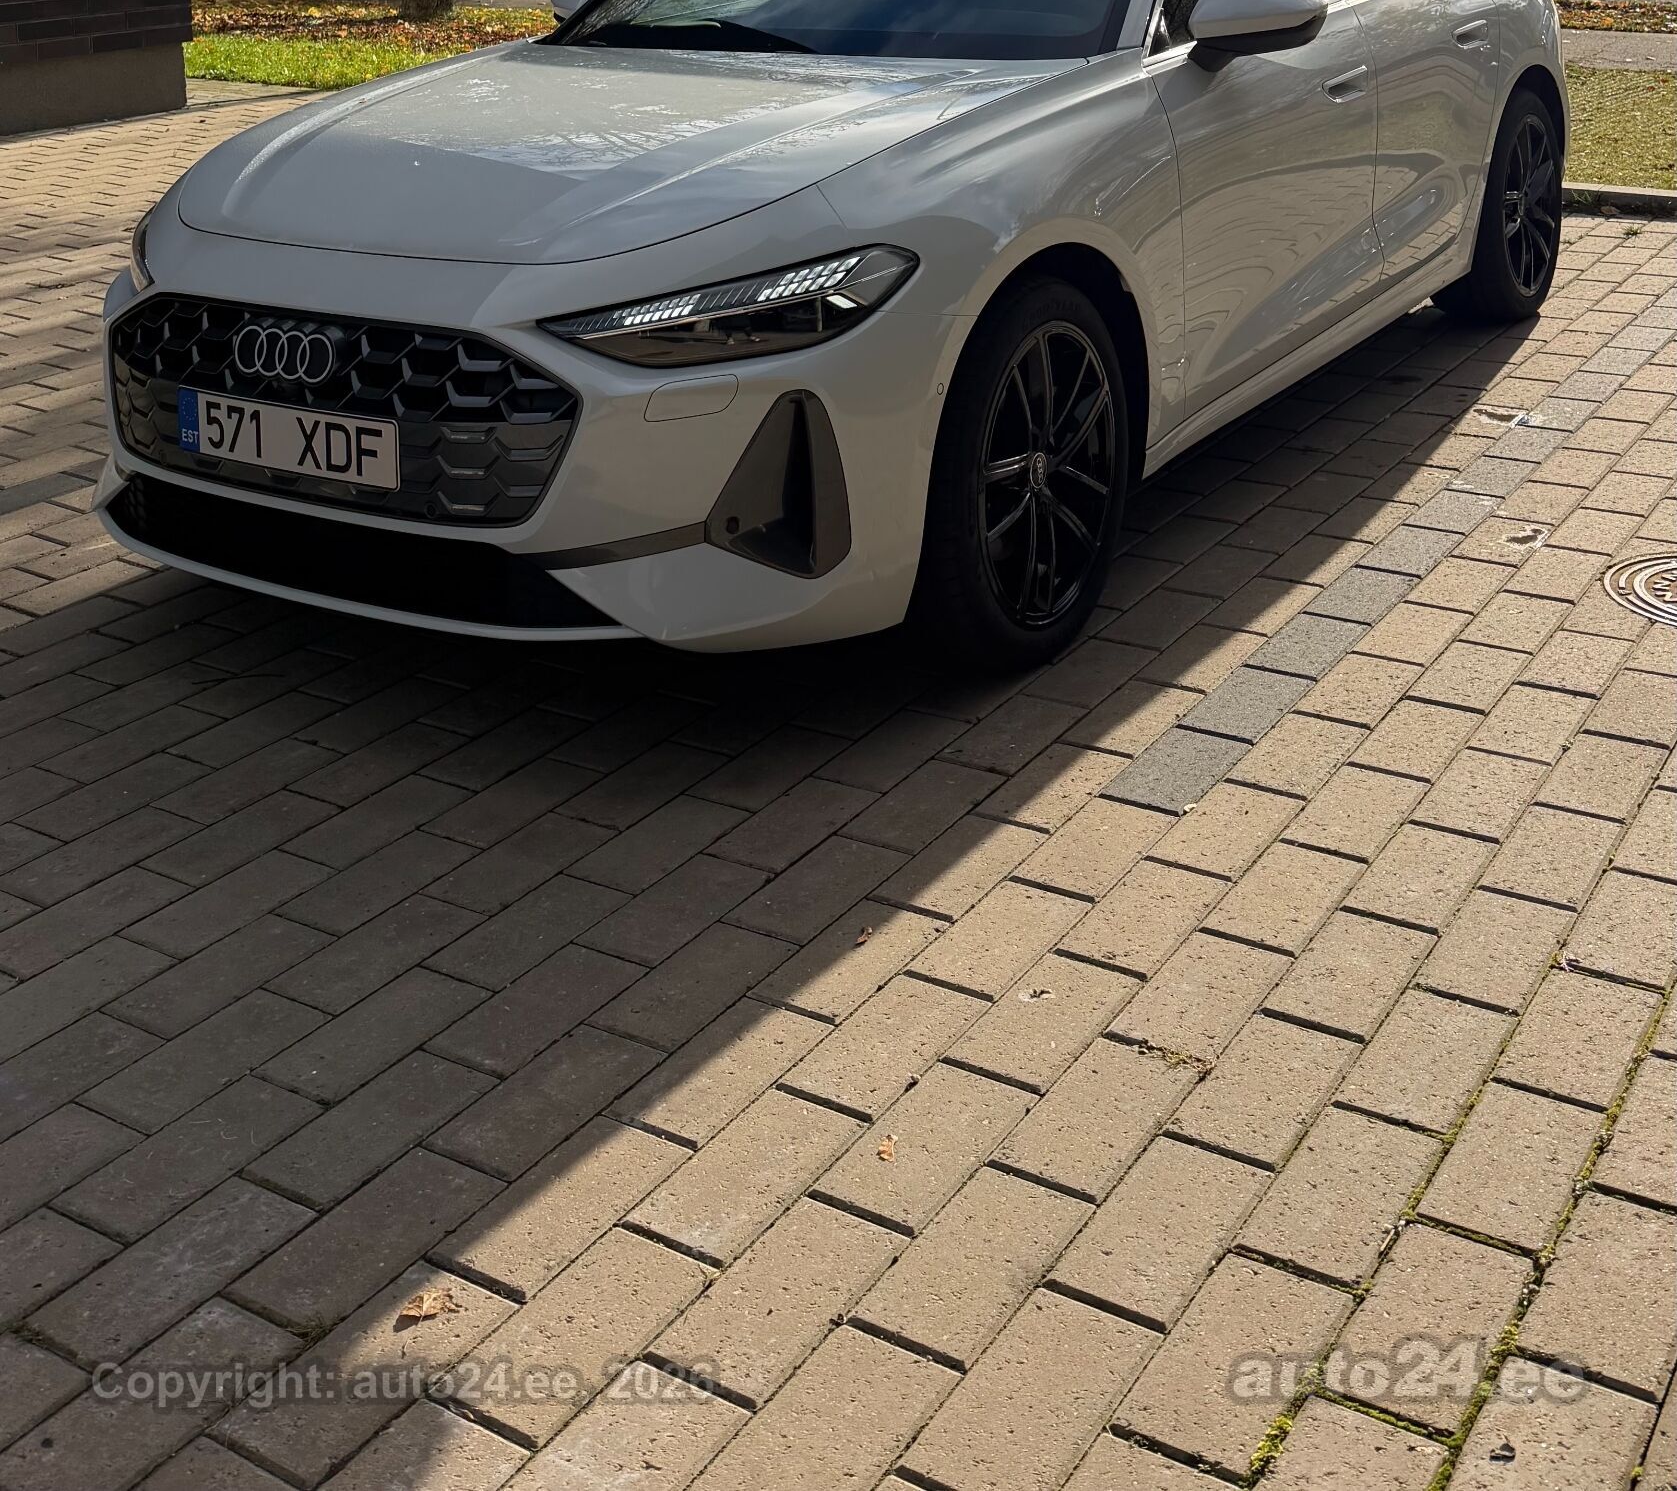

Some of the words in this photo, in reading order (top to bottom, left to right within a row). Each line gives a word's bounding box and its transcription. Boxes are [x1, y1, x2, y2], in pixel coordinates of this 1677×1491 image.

[181, 428, 199, 444] EST
[205, 400, 262, 458] 571
[296, 416, 383, 476] XDF
